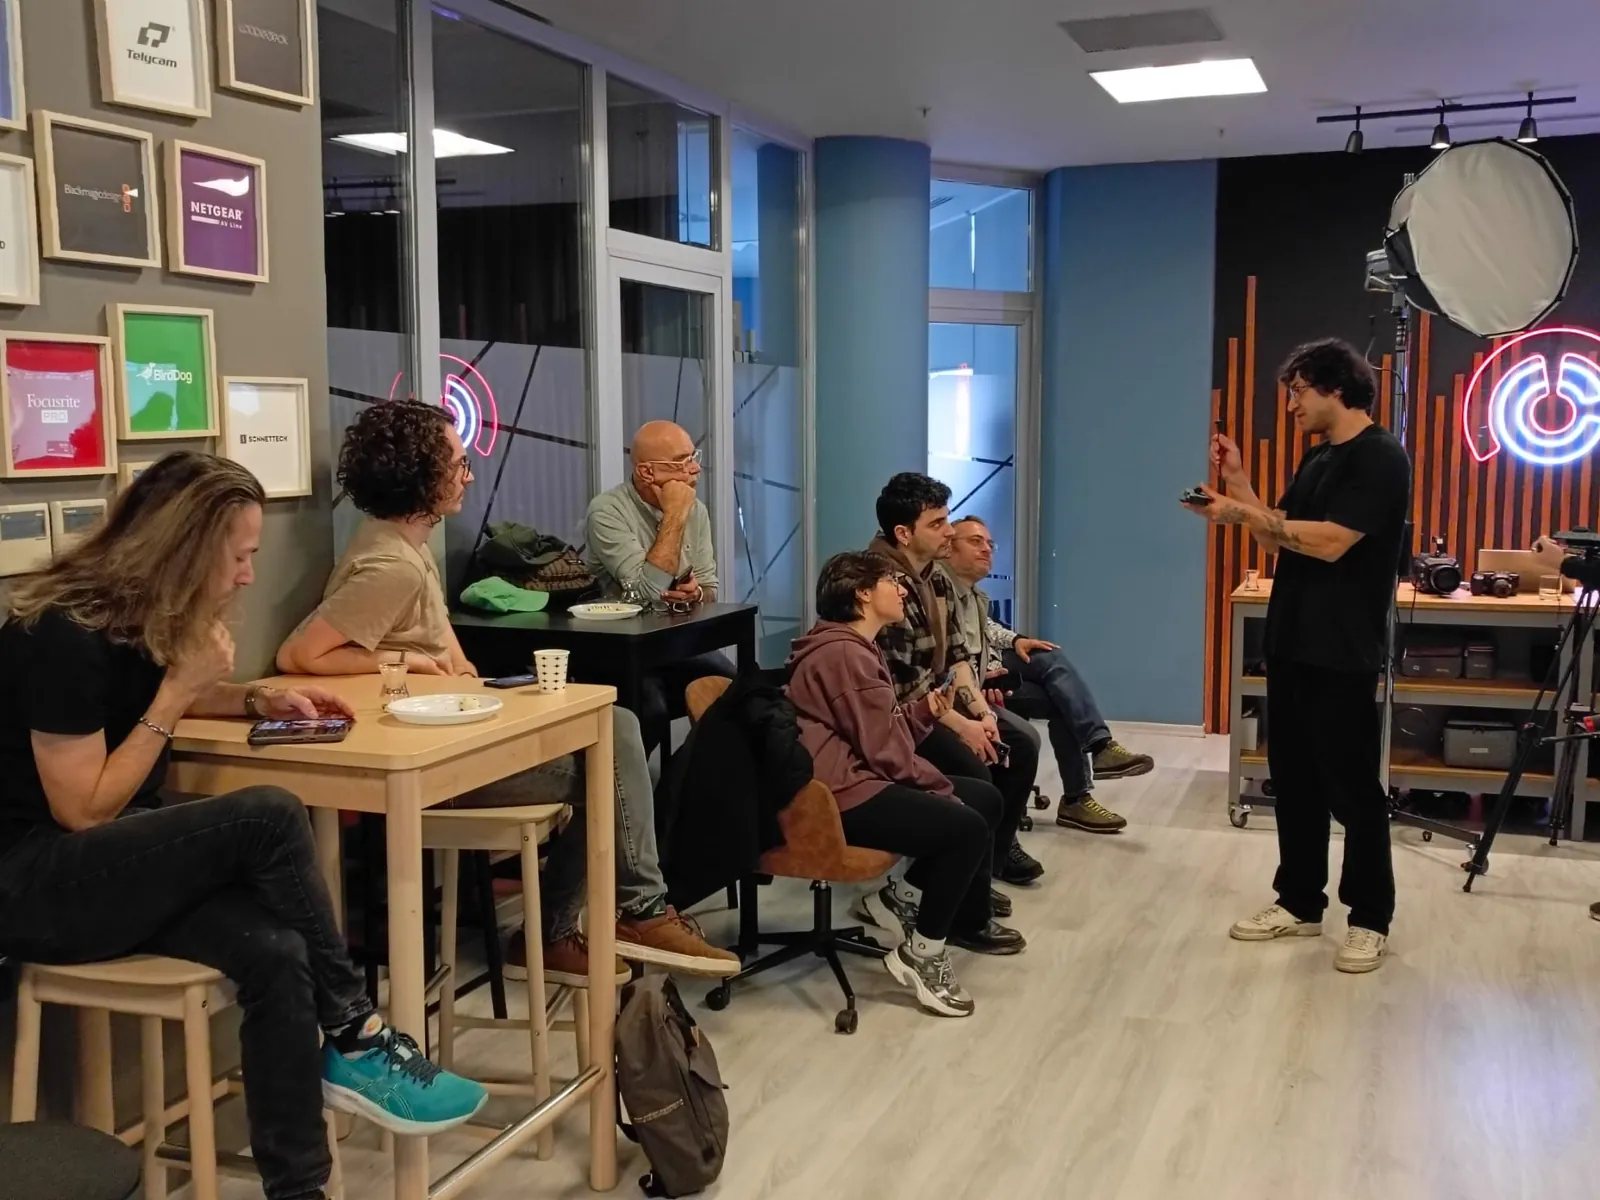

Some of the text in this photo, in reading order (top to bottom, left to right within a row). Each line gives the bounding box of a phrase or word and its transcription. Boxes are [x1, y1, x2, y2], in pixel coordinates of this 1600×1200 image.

[126, 49, 177, 68] Telycam
[191, 200, 243, 221] NETGEAR
[154, 370, 192, 384] BirdDog
[27, 394, 80, 409] Focusrite
